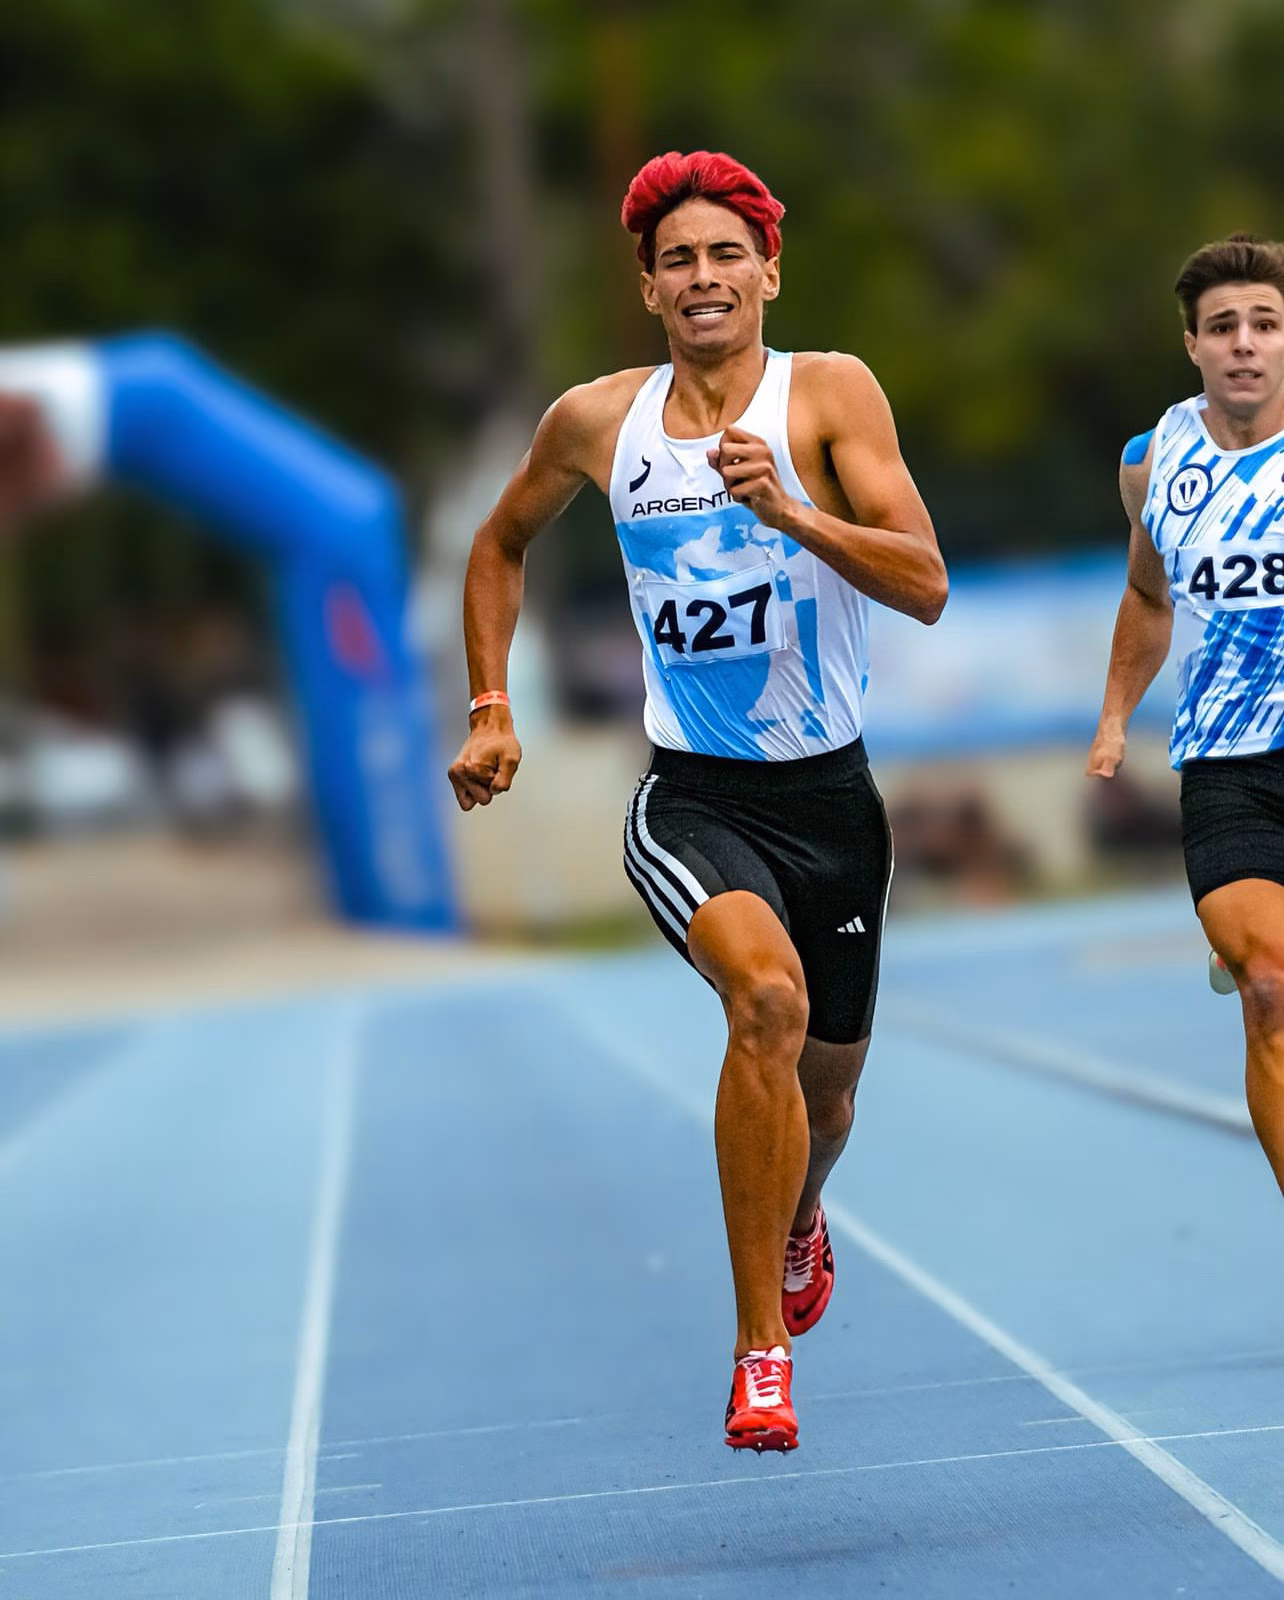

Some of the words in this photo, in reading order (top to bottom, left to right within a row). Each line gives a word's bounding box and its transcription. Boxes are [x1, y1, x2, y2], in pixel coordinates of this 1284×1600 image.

[631, 490, 732, 518] ARGENTI
[1188, 552, 1284, 601] 428
[653, 581, 773, 655] 427
